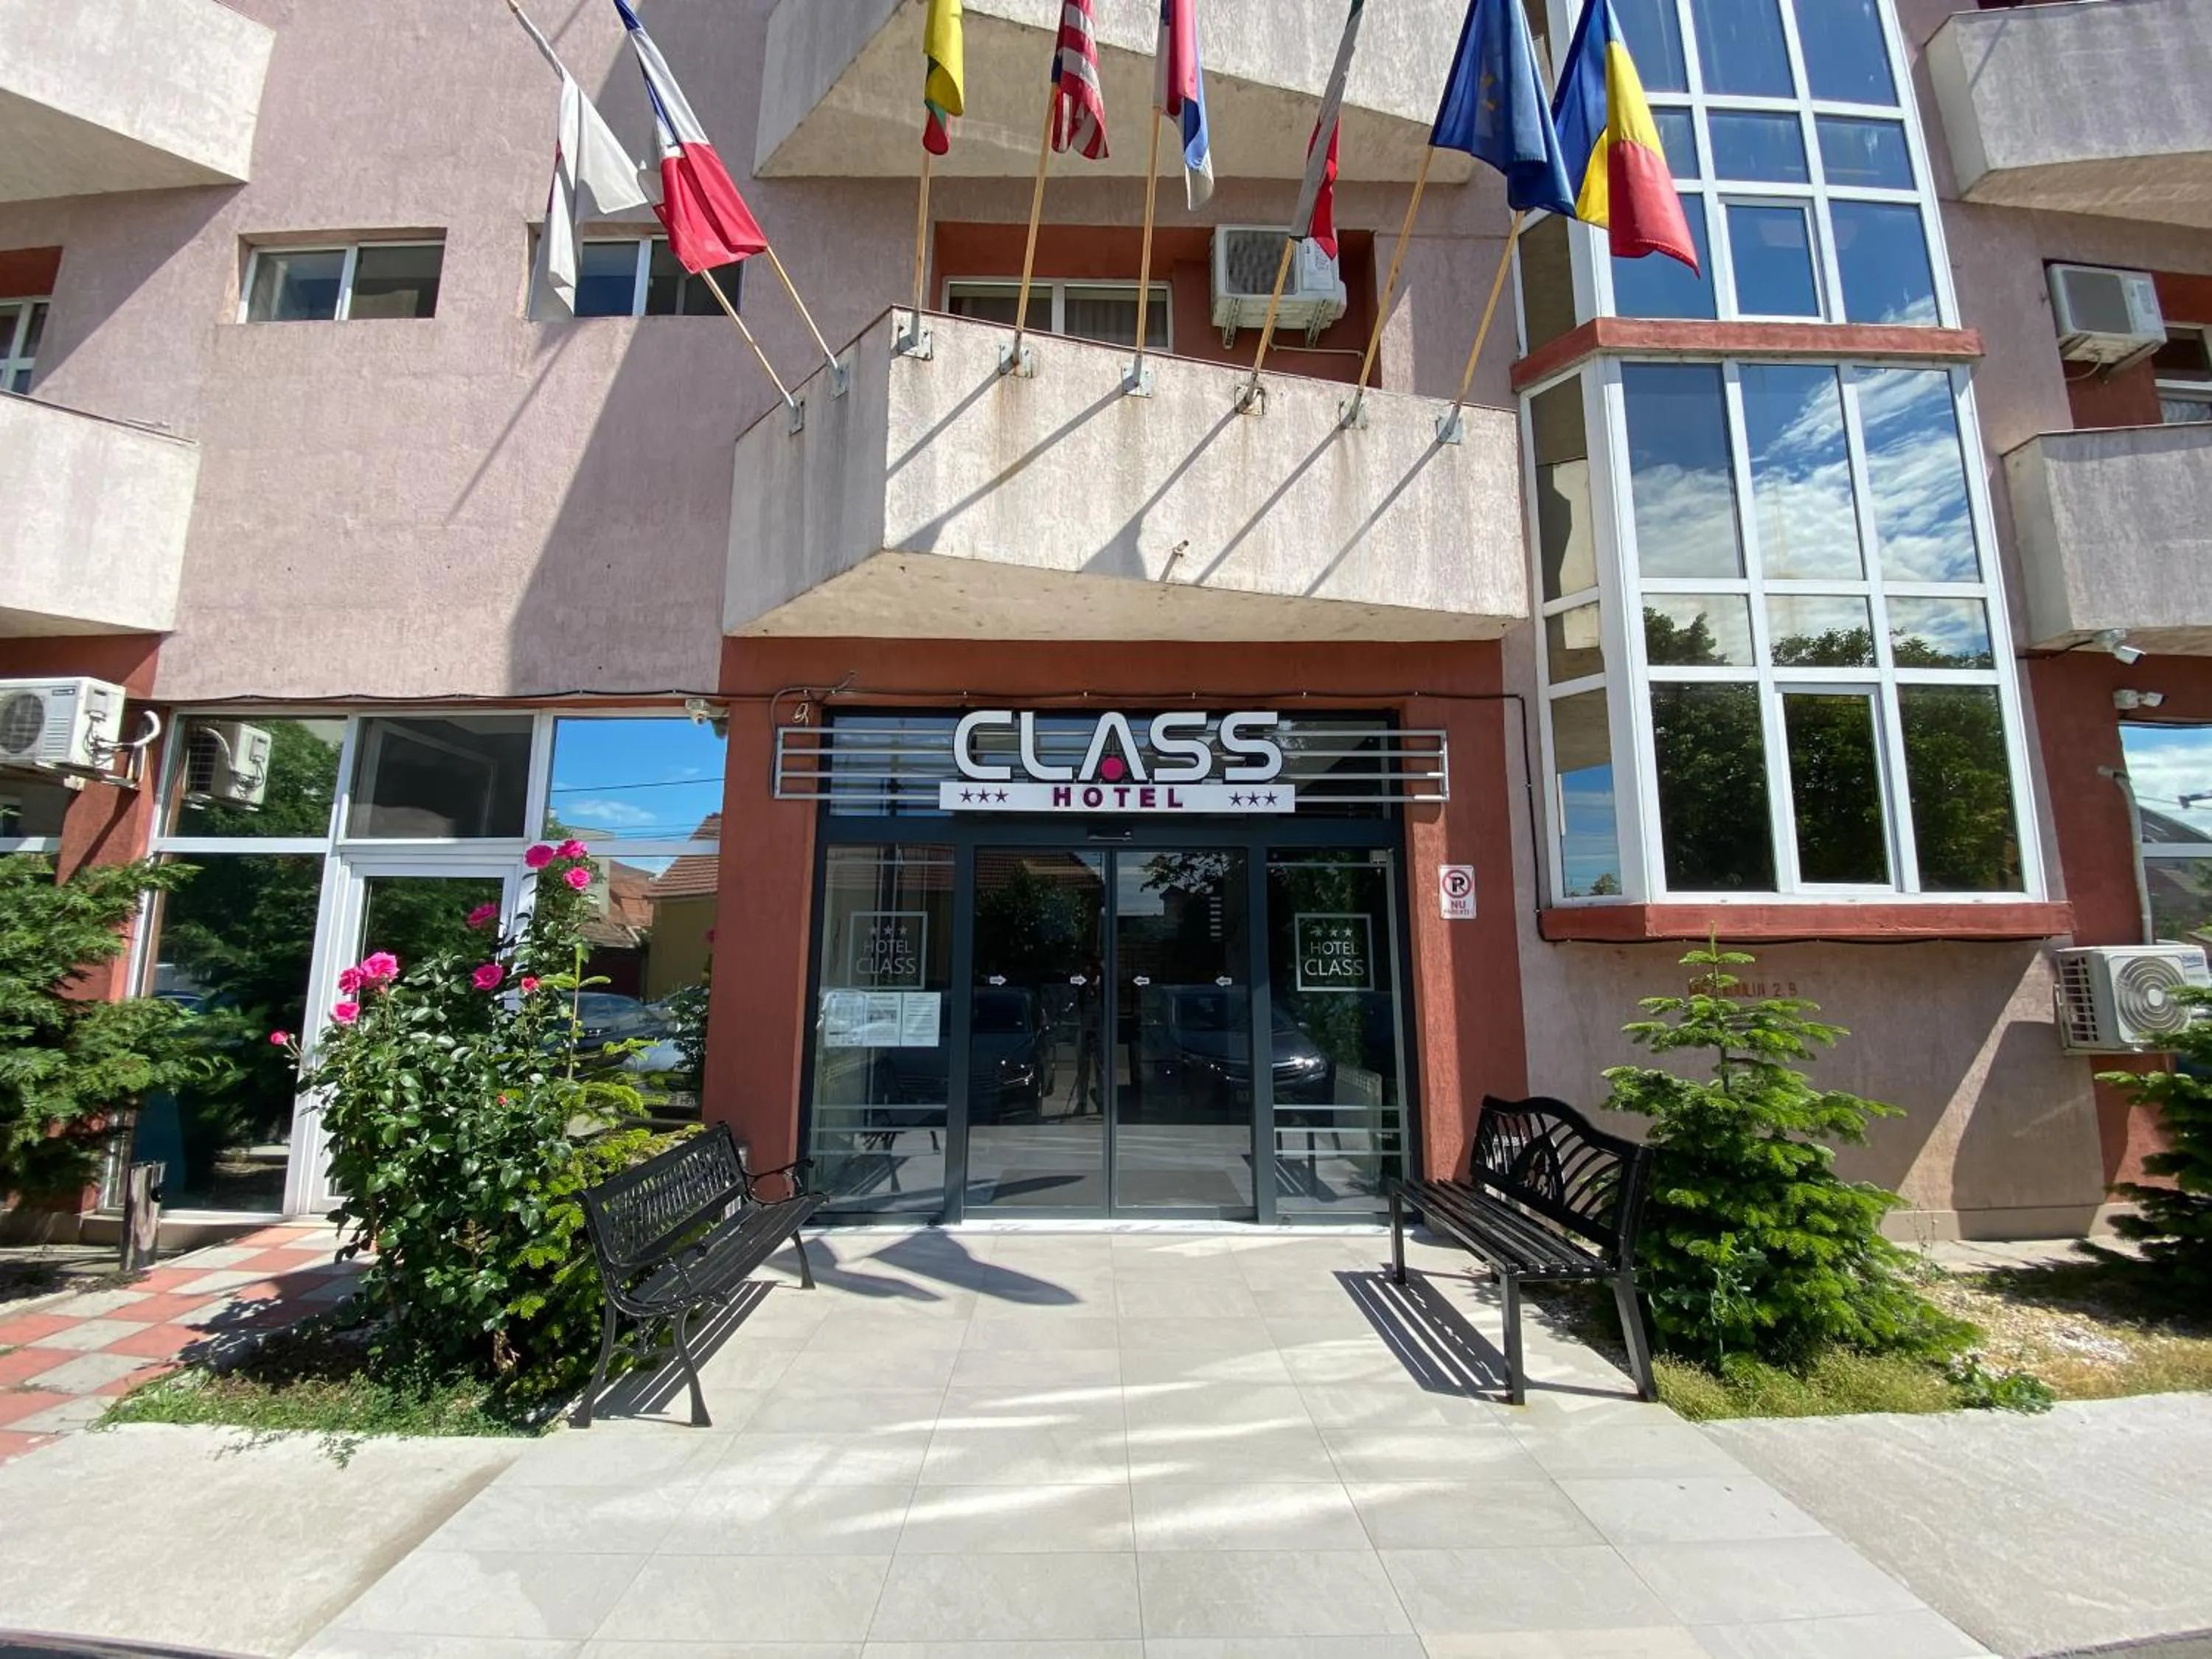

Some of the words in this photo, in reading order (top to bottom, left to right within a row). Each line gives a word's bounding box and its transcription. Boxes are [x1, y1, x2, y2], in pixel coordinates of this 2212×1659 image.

[953, 710, 1283, 781] CLASS
[1053, 787, 1183, 808] HOTEL
[1450, 900, 1467, 909] NU
[863, 940, 912, 953] HOTEL
[1310, 942, 1359, 955] HOTEL
[856, 957, 917, 975] CLASS
[1305, 959, 1364, 976] CLASS
